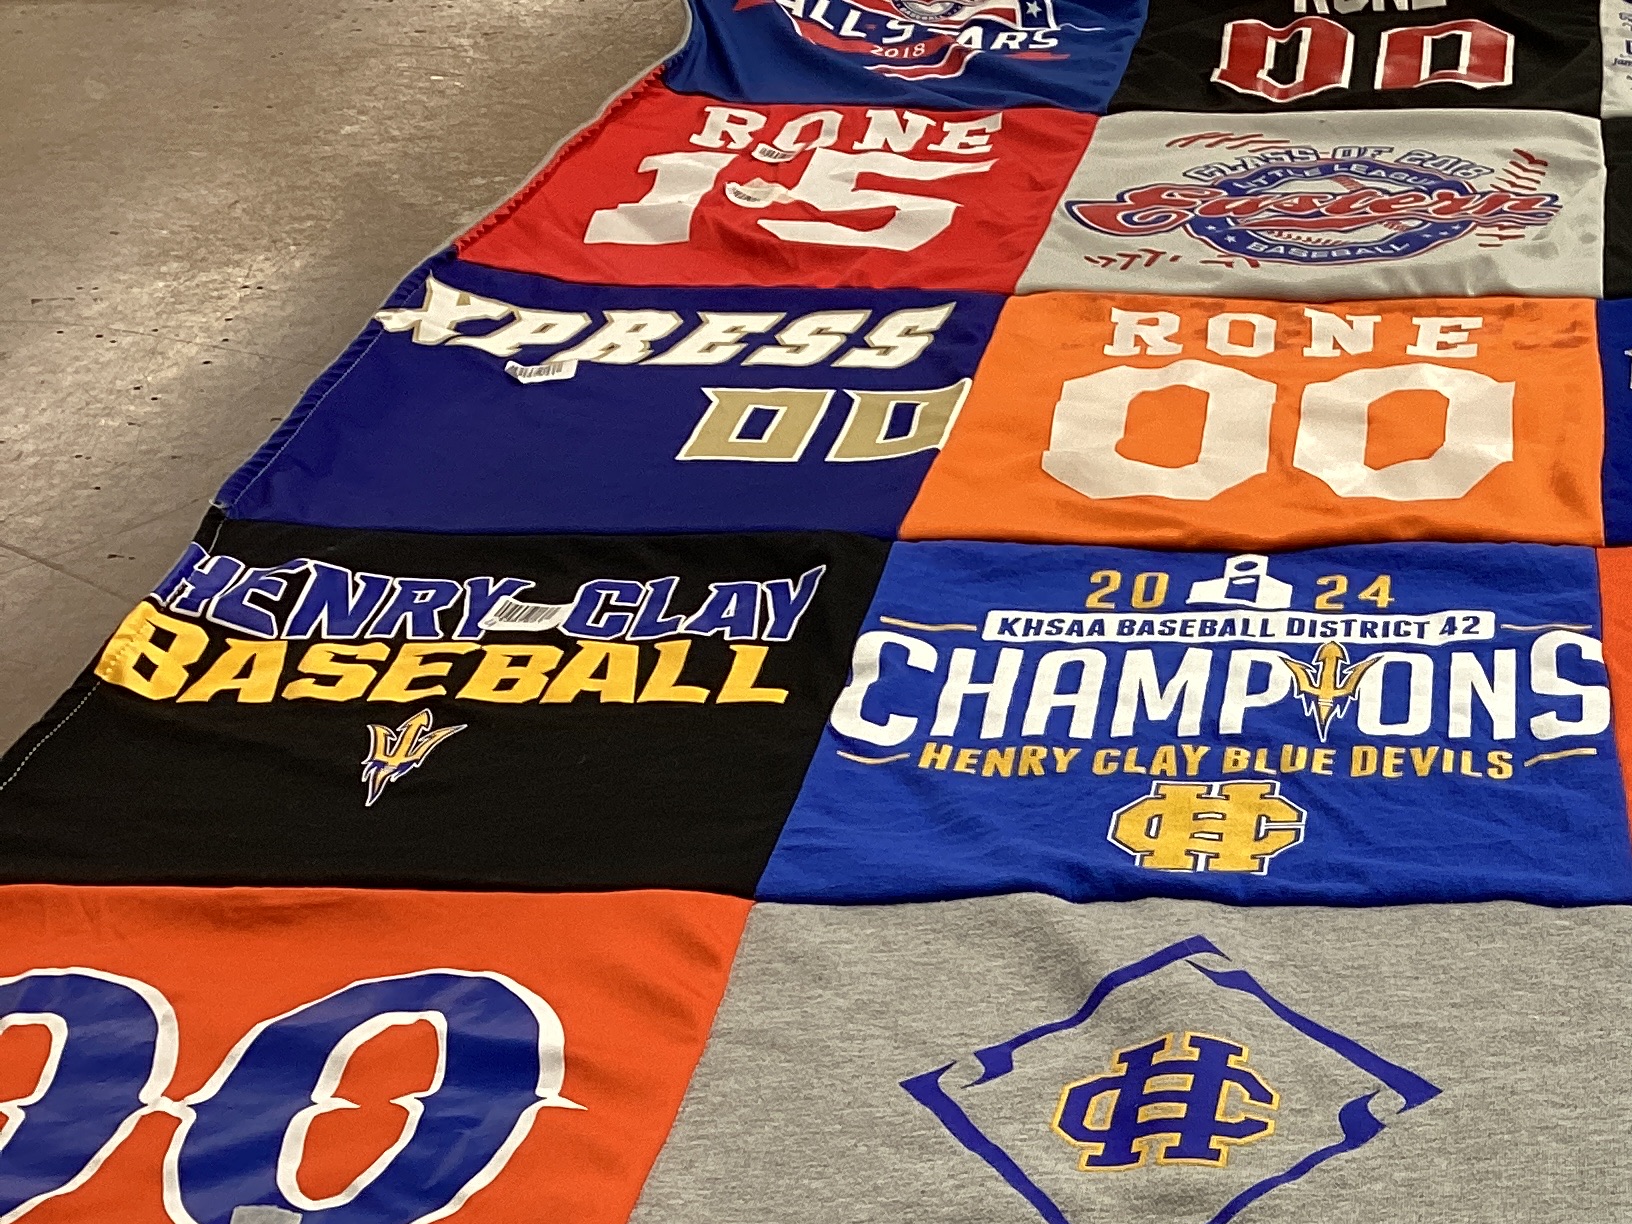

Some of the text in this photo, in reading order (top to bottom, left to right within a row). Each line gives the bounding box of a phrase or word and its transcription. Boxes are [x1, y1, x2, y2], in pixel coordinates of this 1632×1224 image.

[870, 43, 926, 58] 2018
[689, 106, 1003, 155] RONE
[1182, 145, 1494, 181] CLASS OF 2018
[583, 147, 999, 252] 15
[1065, 182, 1563, 236] Eastern
[1247, 242, 1410, 258] BASEBALL
[1103, 307, 1483, 358] RONE
[1041, 359, 1516, 501] 00
[149, 541, 828, 644] HENRY CLAY
[1085, 570, 1395, 610] 20 24
[997, 615, 1481, 639] KHSAA BASEBALL DISTRICT 42
[94, 600, 790, 705] BASEBALL
[918, 742, 1515, 780] HENRY CLAY BLUE DEVILS
